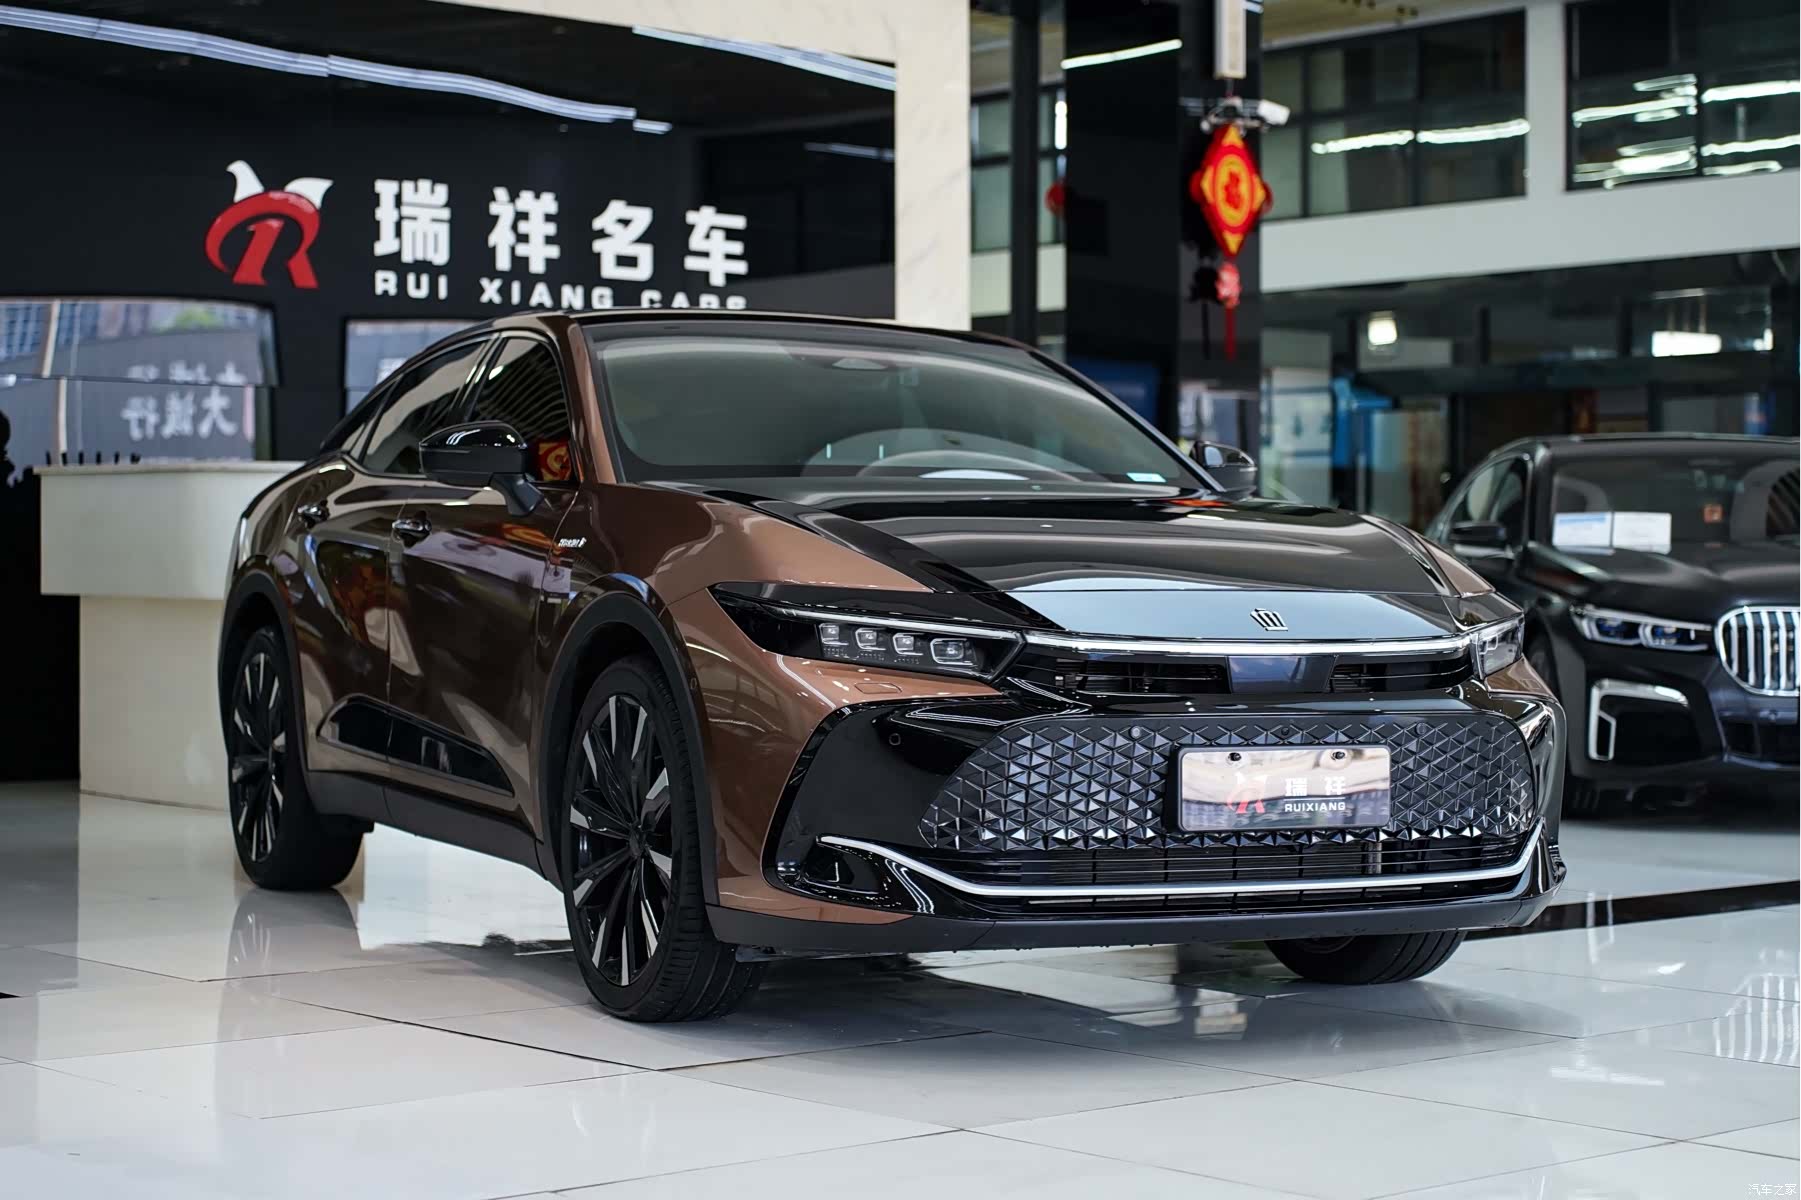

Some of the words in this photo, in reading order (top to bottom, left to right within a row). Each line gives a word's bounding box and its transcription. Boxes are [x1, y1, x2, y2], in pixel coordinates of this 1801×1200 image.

[373, 177, 750, 287] 瑞祥名车
[374, 269, 449, 300] RUI
[479, 276, 614, 310] XIANG
[1284, 775, 1347, 797] 瑞祥
[1284, 801, 1347, 812] RUIXIANG
